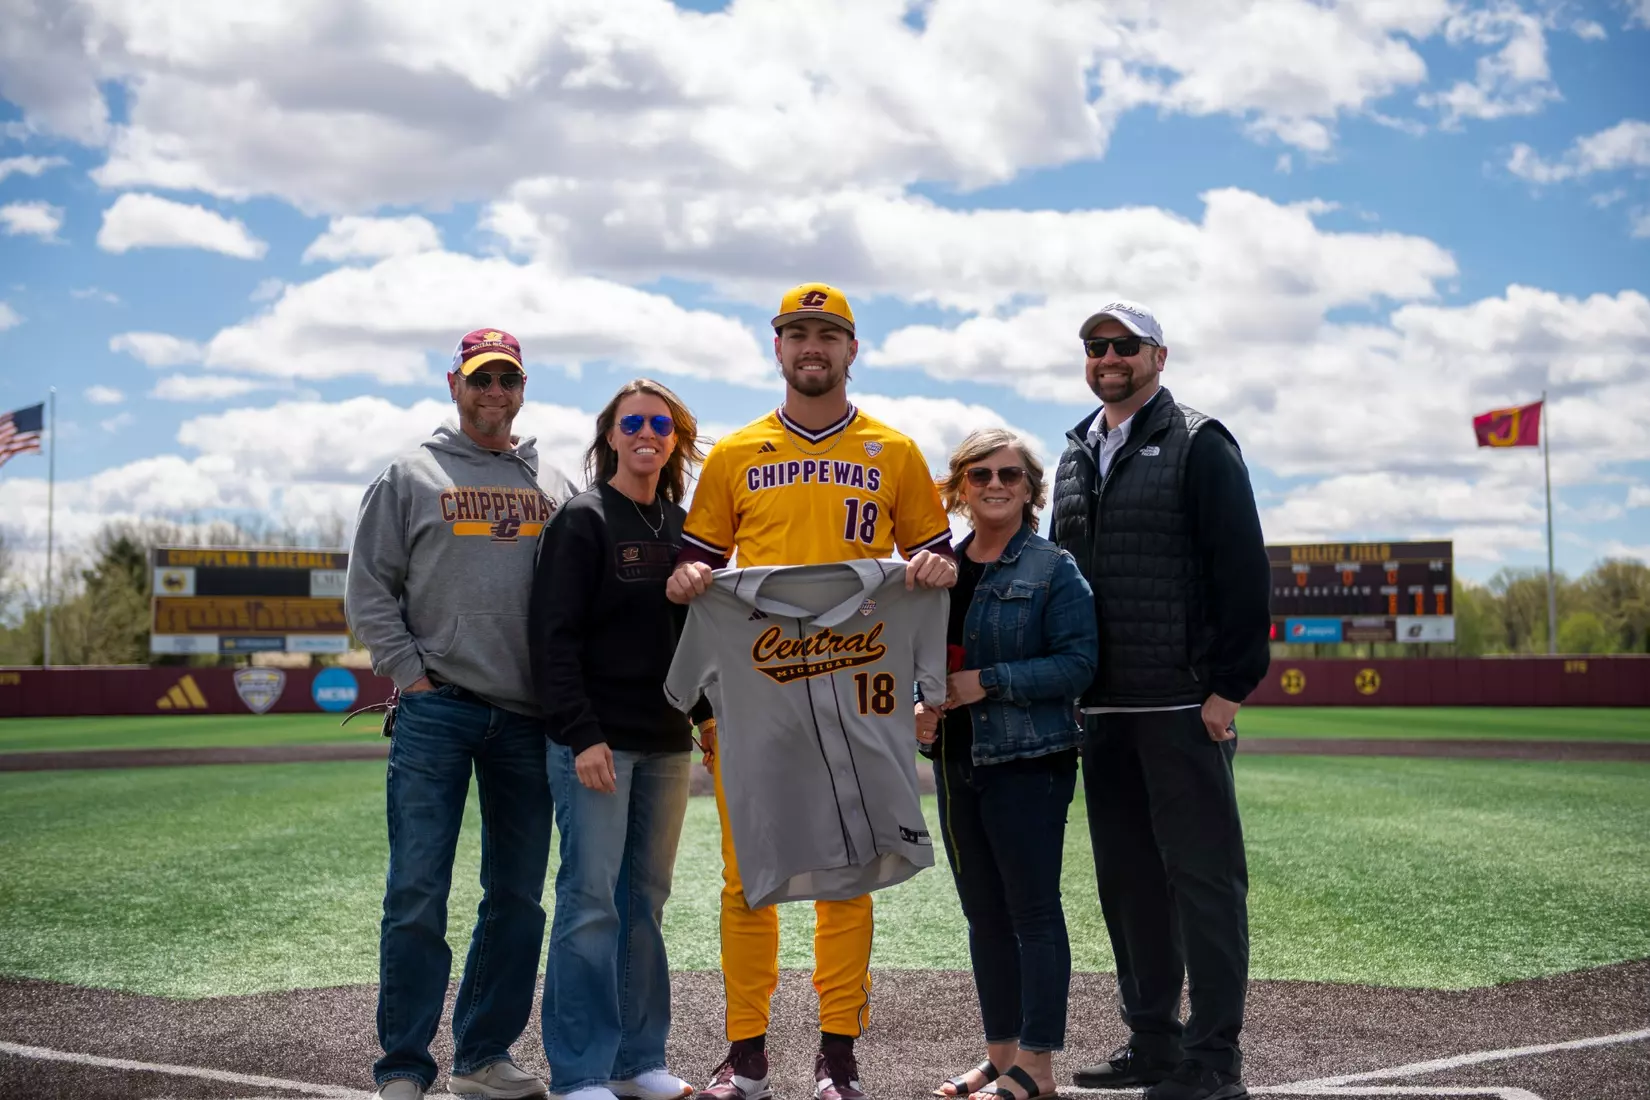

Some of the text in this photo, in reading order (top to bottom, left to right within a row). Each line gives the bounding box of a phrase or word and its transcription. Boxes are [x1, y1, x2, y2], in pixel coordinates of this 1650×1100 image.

[747, 459, 881, 492] CHIPPEWAS
[843, 498, 879, 545] 18
[167, 551, 335, 568] CHIPPEWA BASEBALL
[752, 621, 887, 663] Central
[776, 658, 853, 678] MICHIGAN
[853, 672, 896, 716] 18
